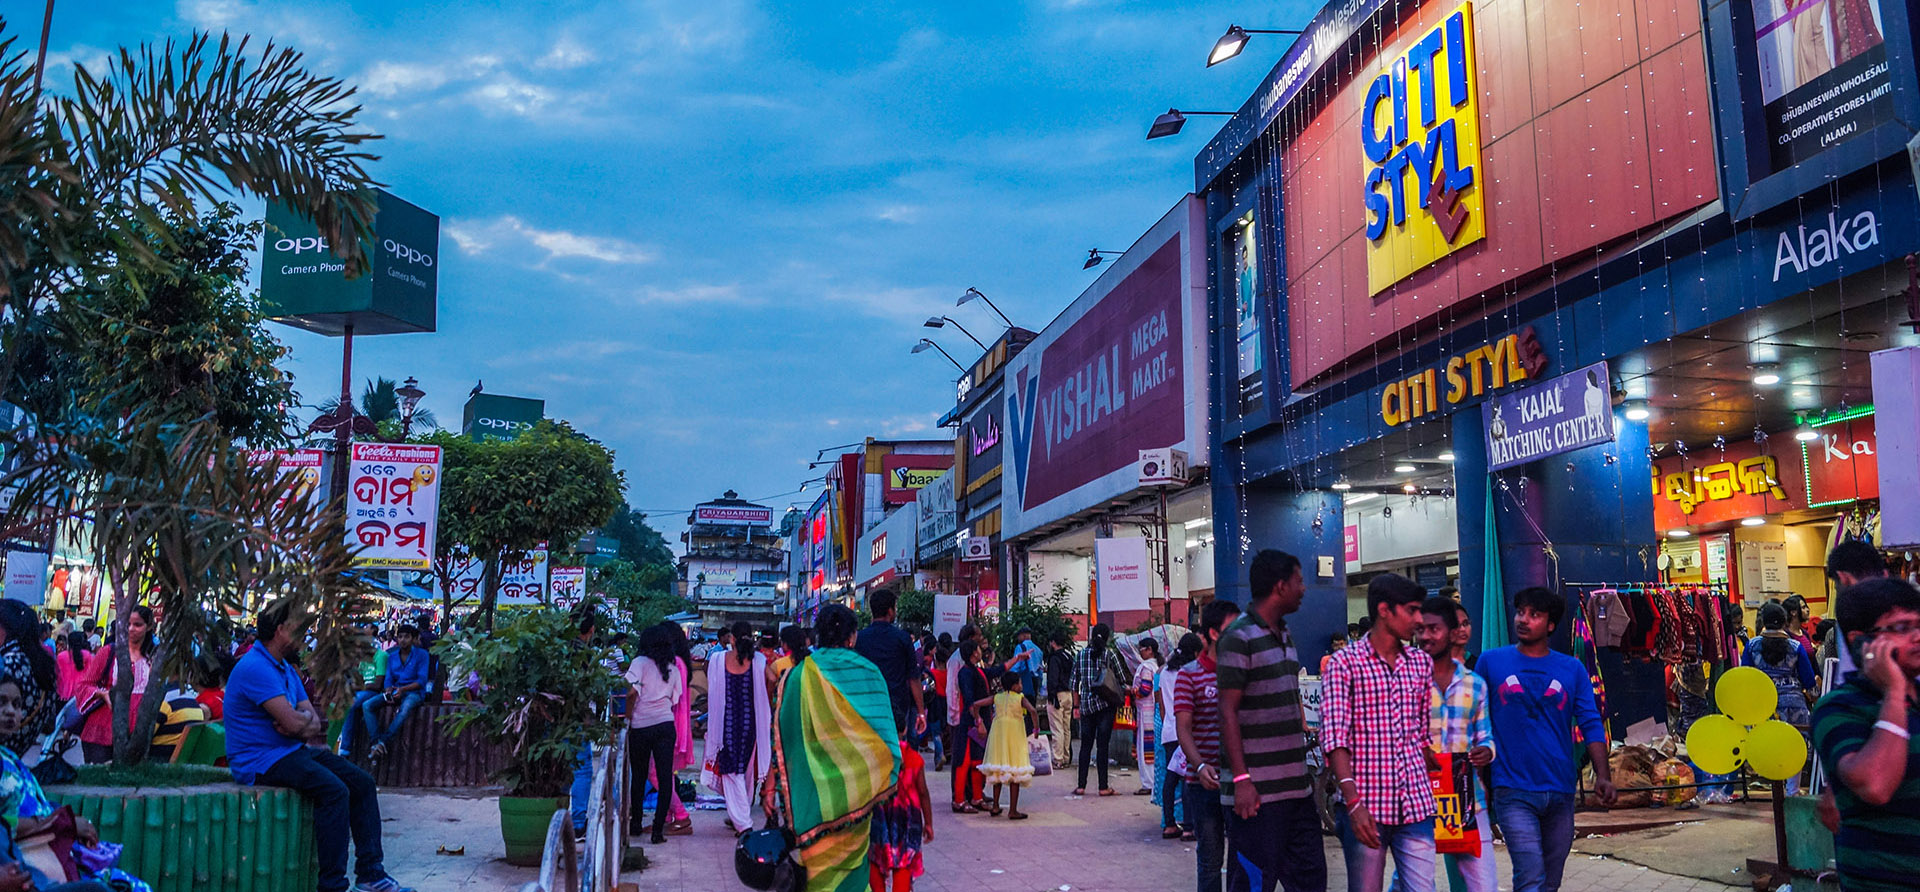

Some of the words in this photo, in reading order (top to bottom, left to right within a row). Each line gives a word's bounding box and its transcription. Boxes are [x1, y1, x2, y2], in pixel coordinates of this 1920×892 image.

[1259, 43, 1313, 119] Bhubaneswar
[1361, 11, 1467, 163] CITI
[1781, 86, 1841, 124] BHUBANESWAR
[1778, 133, 1792, 146] CO.
[1791, 111, 1835, 139] OPERATIVE
[1834, 95, 1866, 119] STORES
[1364, 118, 1474, 245] STYLE
[274, 236, 331, 255] opp
[281, 264, 318, 276] Camera
[383, 238, 434, 268] oppo
[1772, 210, 1879, 283] Alaka
[387, 266, 410, 284] Camera
[409, 273, 427, 290] Phone
[1131, 309, 1169, 362] MEGA
[1131, 351, 1168, 400] MART
[1381, 368, 1438, 428] CITI
[1446, 325, 1548, 404] STYLE
[1041, 344, 1126, 464] VISHAL
[1520, 389, 1565, 425] KAJAL
[357, 444, 394, 460] Geeta
[1488, 426, 1554, 466] MATCHING
[1554, 413, 1608, 448] CENTER
[701, 509, 769, 517] PRIYADARSHINI
[356, 519, 428, 557] କମ୍
